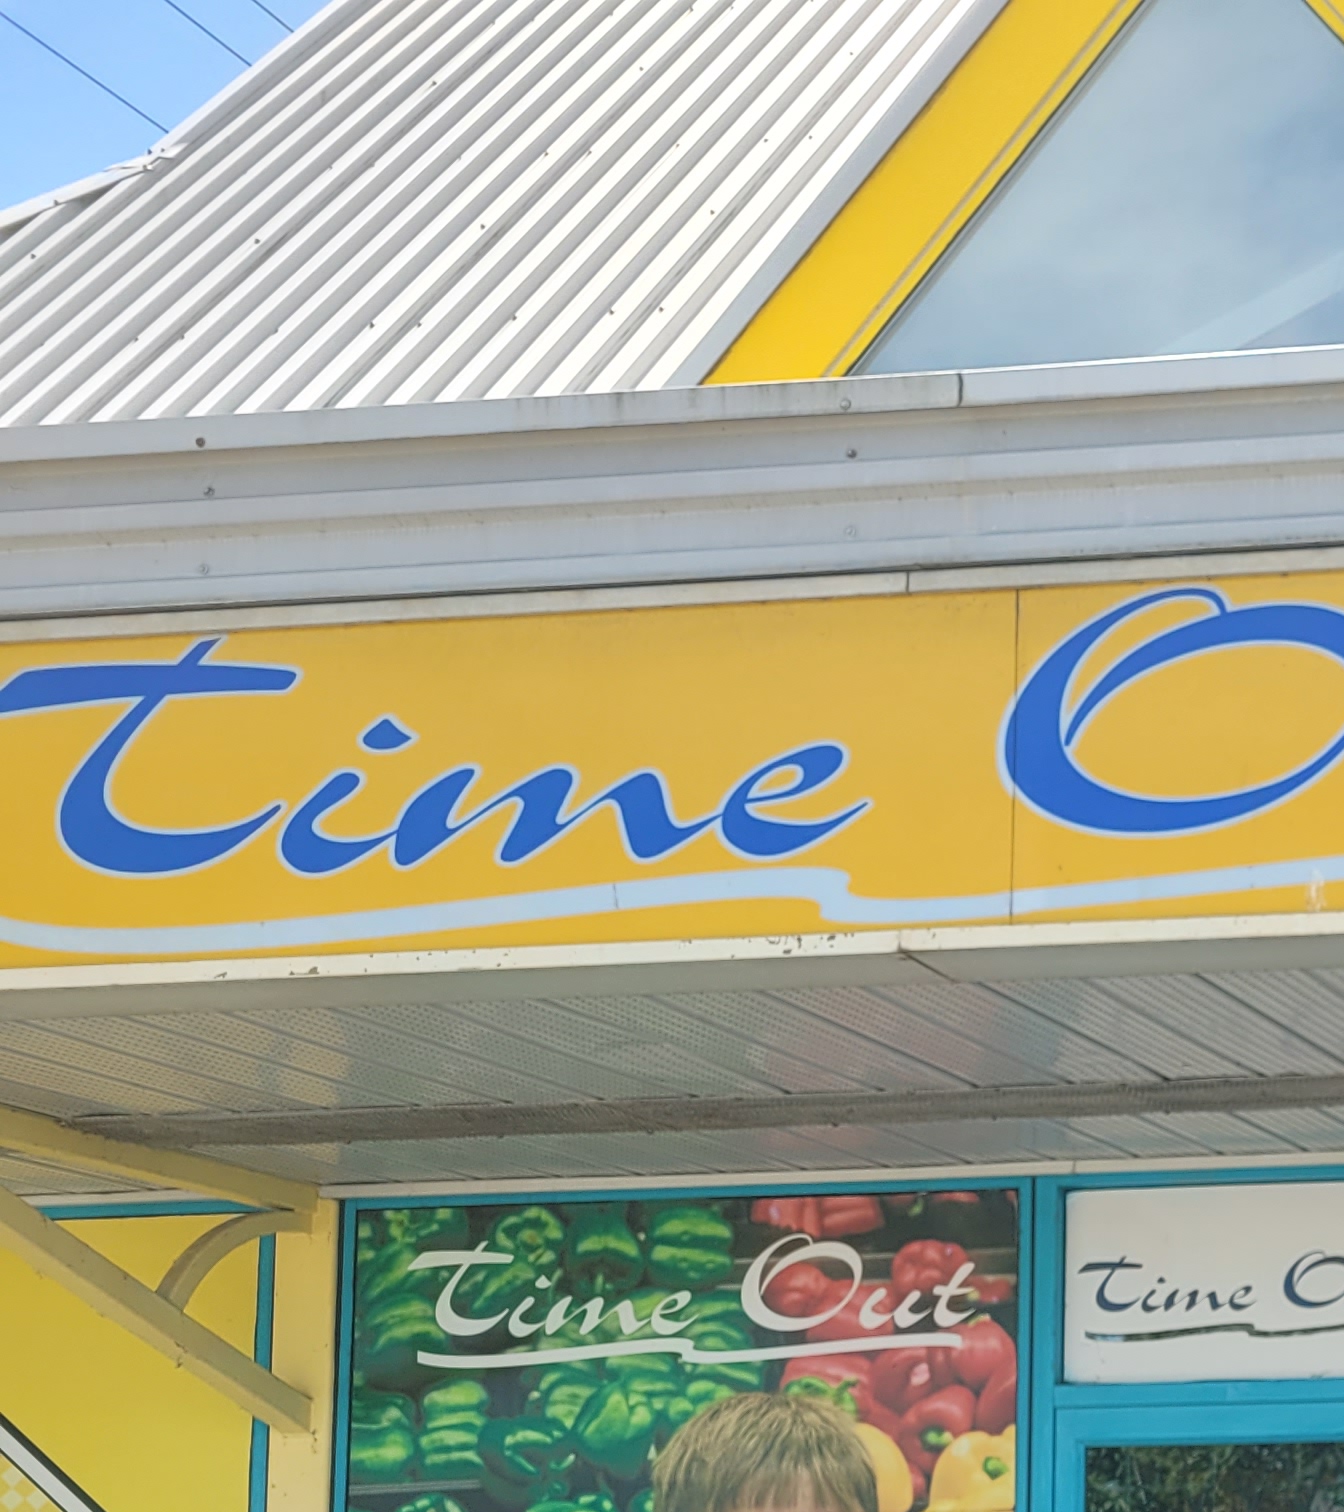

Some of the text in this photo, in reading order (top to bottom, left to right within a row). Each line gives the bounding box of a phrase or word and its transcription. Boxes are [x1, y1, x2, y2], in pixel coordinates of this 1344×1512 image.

[0, 635, 870, 877] Time
[406, 1232, 978, 1340] Time Out
[1076, 1254, 1258, 1314] Time
